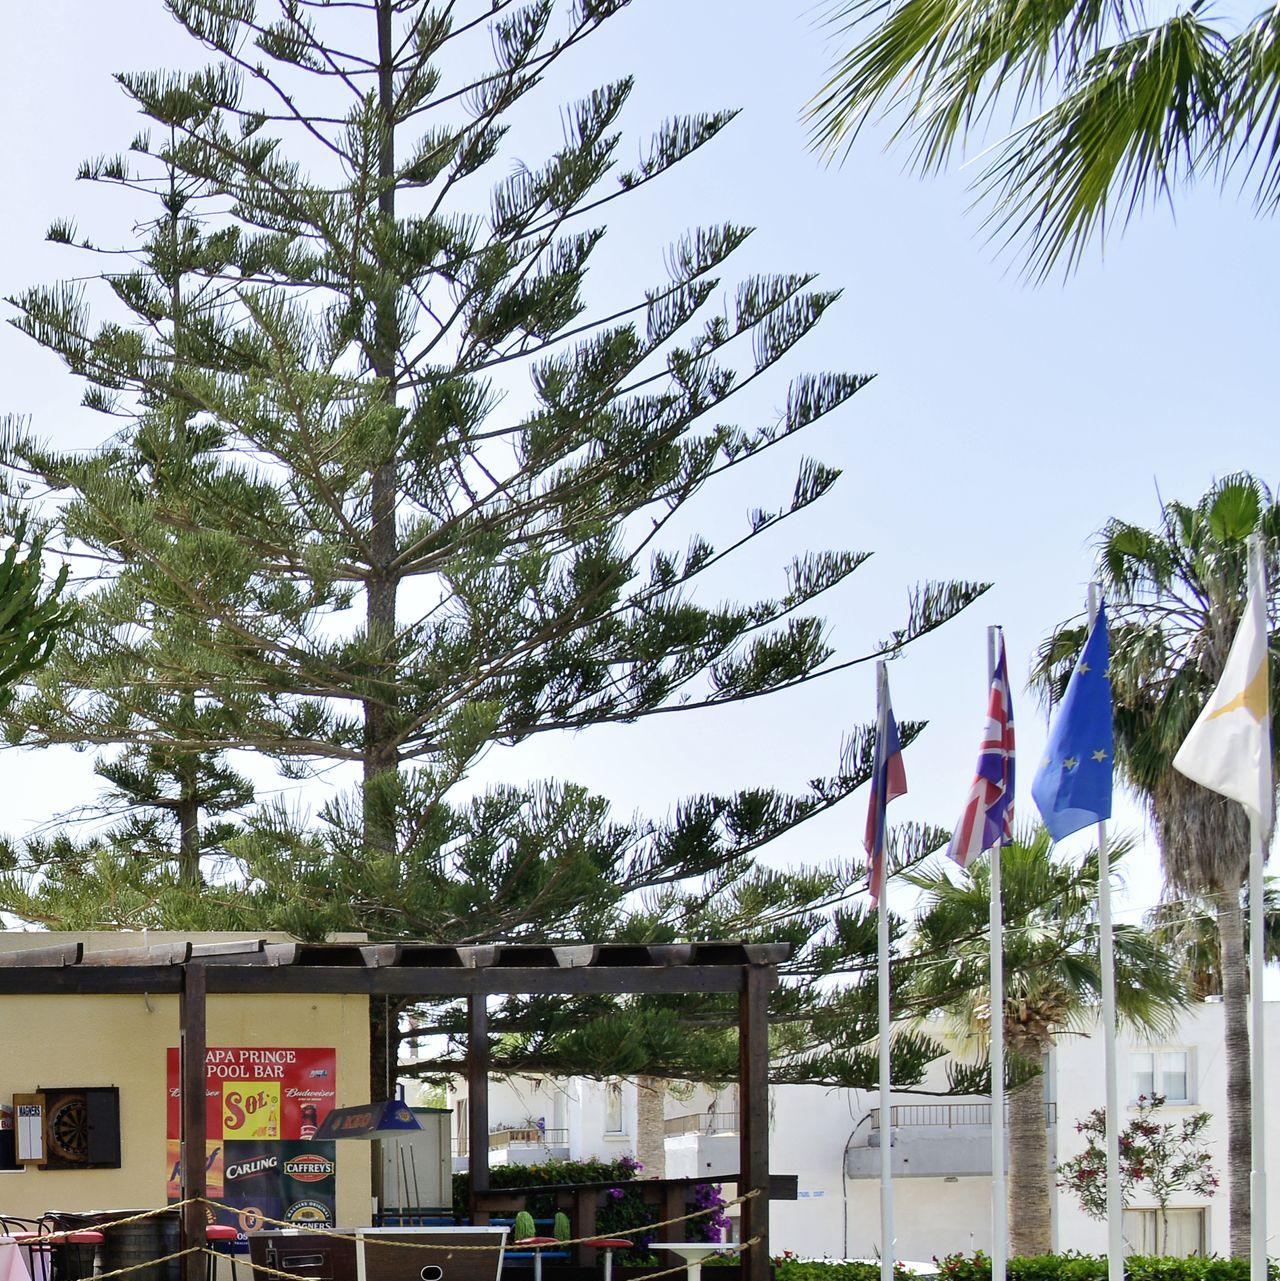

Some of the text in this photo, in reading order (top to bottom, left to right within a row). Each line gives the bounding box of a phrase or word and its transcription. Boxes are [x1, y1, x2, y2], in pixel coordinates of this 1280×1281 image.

[205, 1050, 297, 1064] APA PRINCE
[206, 1065, 285, 1078] POOL BAR
[284, 1087, 335, 1098] Budweiser
[225, 1156, 278, 1180] CARLING
